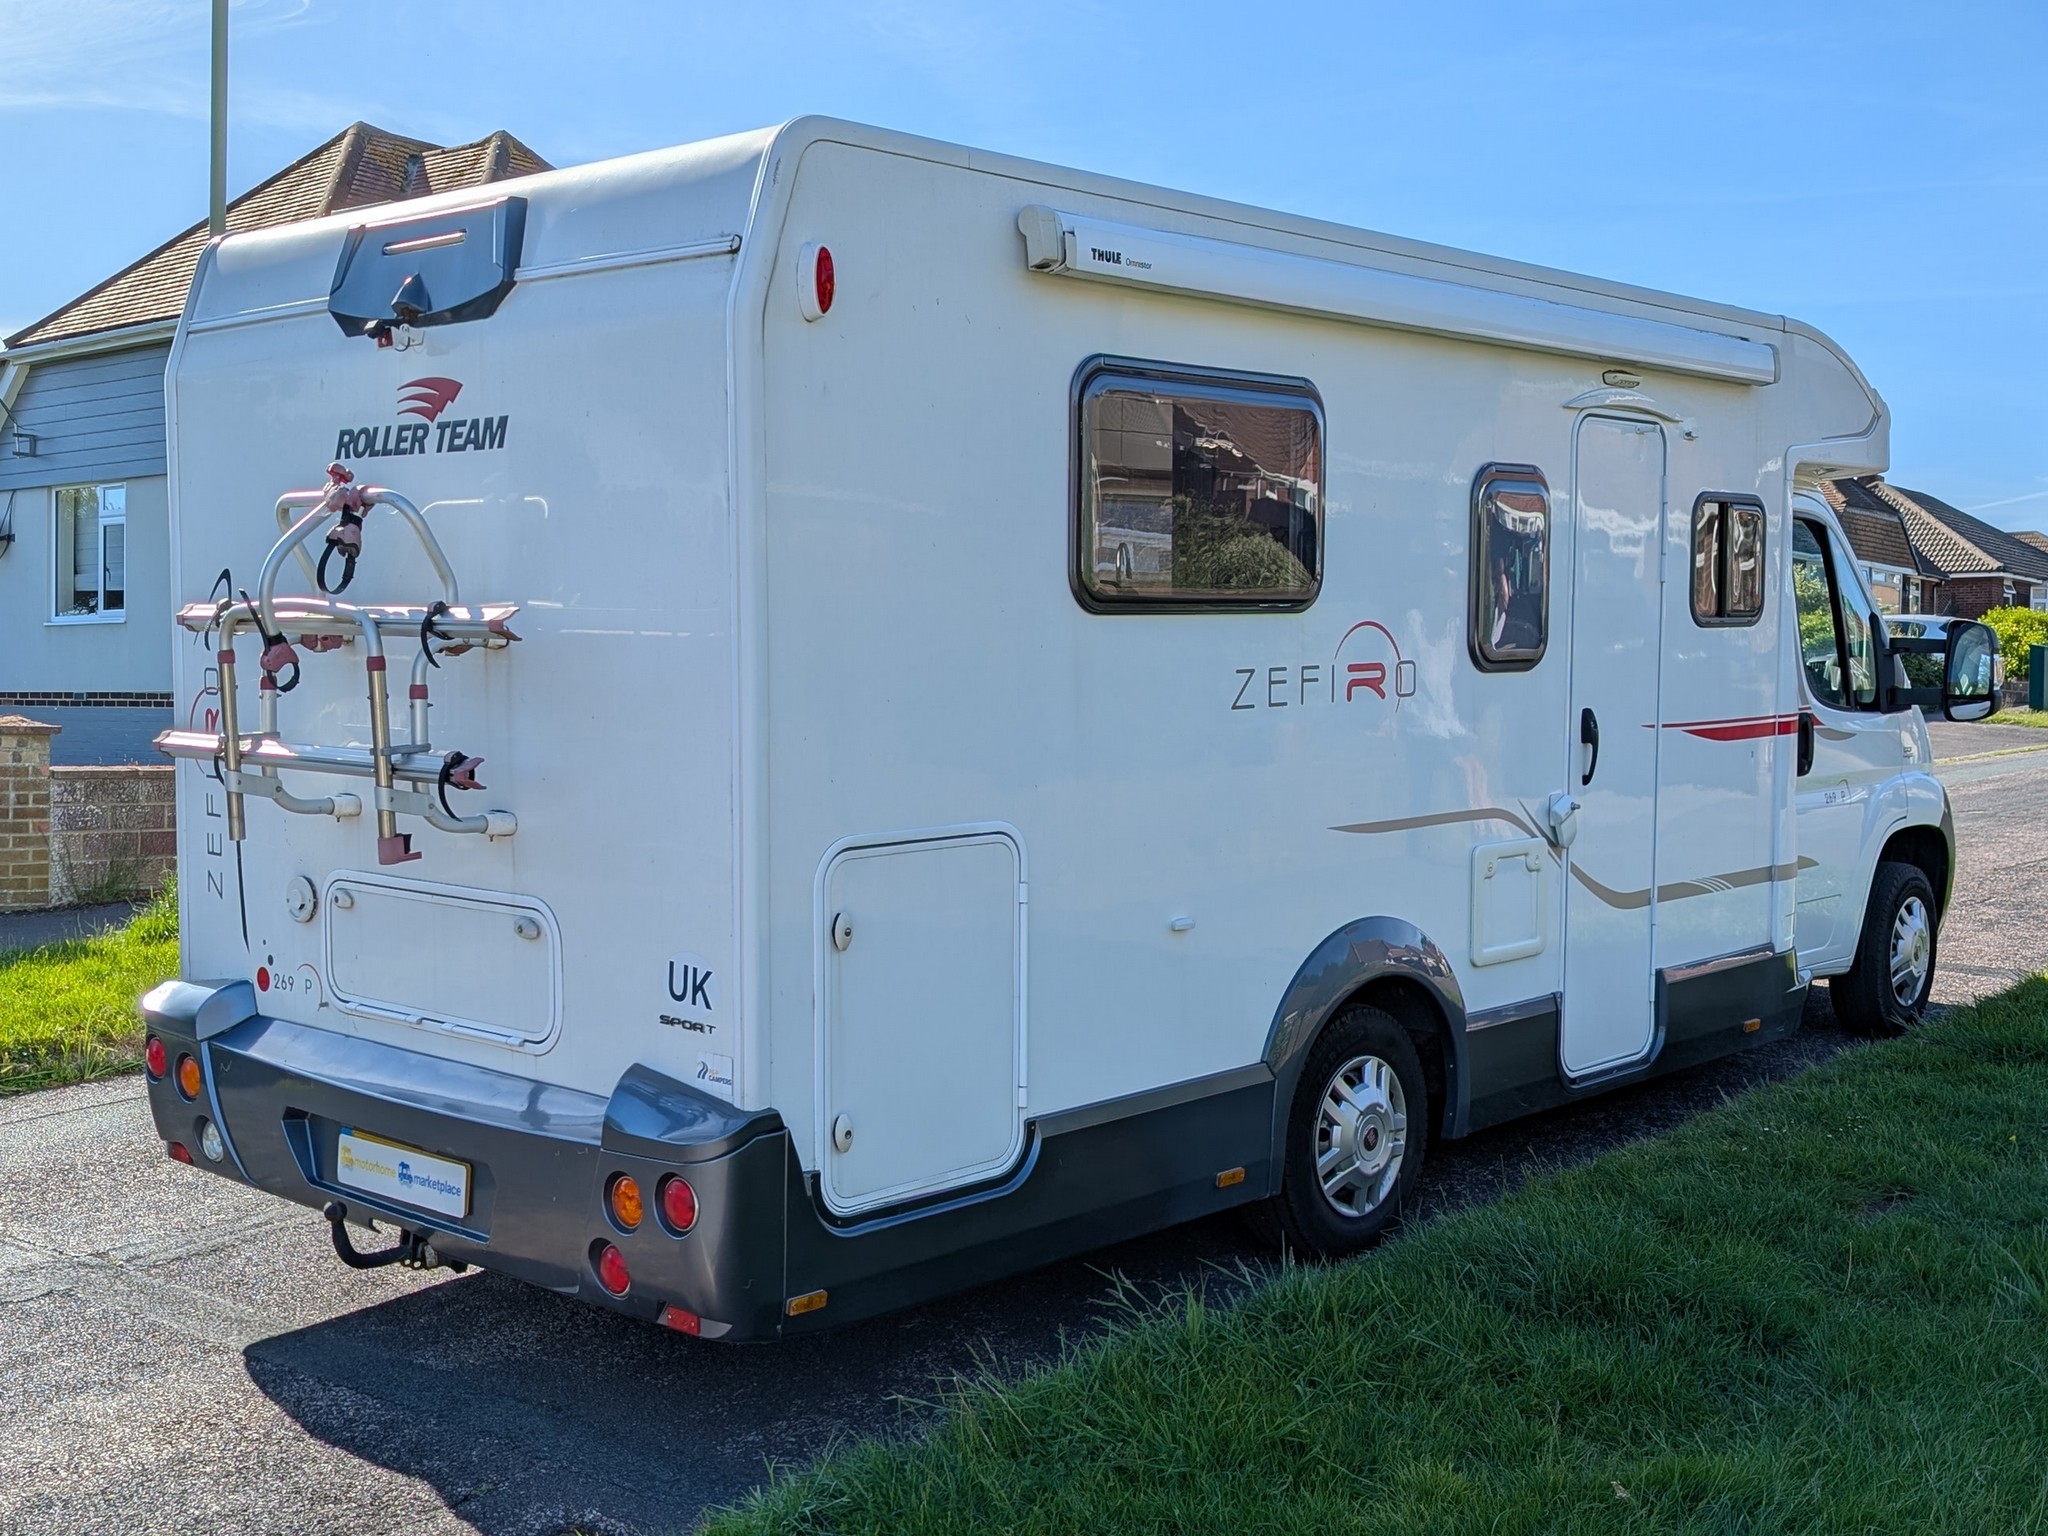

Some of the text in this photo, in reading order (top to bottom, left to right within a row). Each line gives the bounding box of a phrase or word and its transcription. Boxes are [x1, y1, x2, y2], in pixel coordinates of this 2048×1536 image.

[1091, 247, 1122, 265] THULE
[334, 415, 509, 460] ROLLER TEAM
[1231, 659, 1416, 710] ZEFIRO
[273, 973, 313, 995] 269 P
[668, 960, 713, 1010] UK
[659, 1014, 717, 1034] SPORT
[354, 1158, 462, 1197] motorhome marketplace
